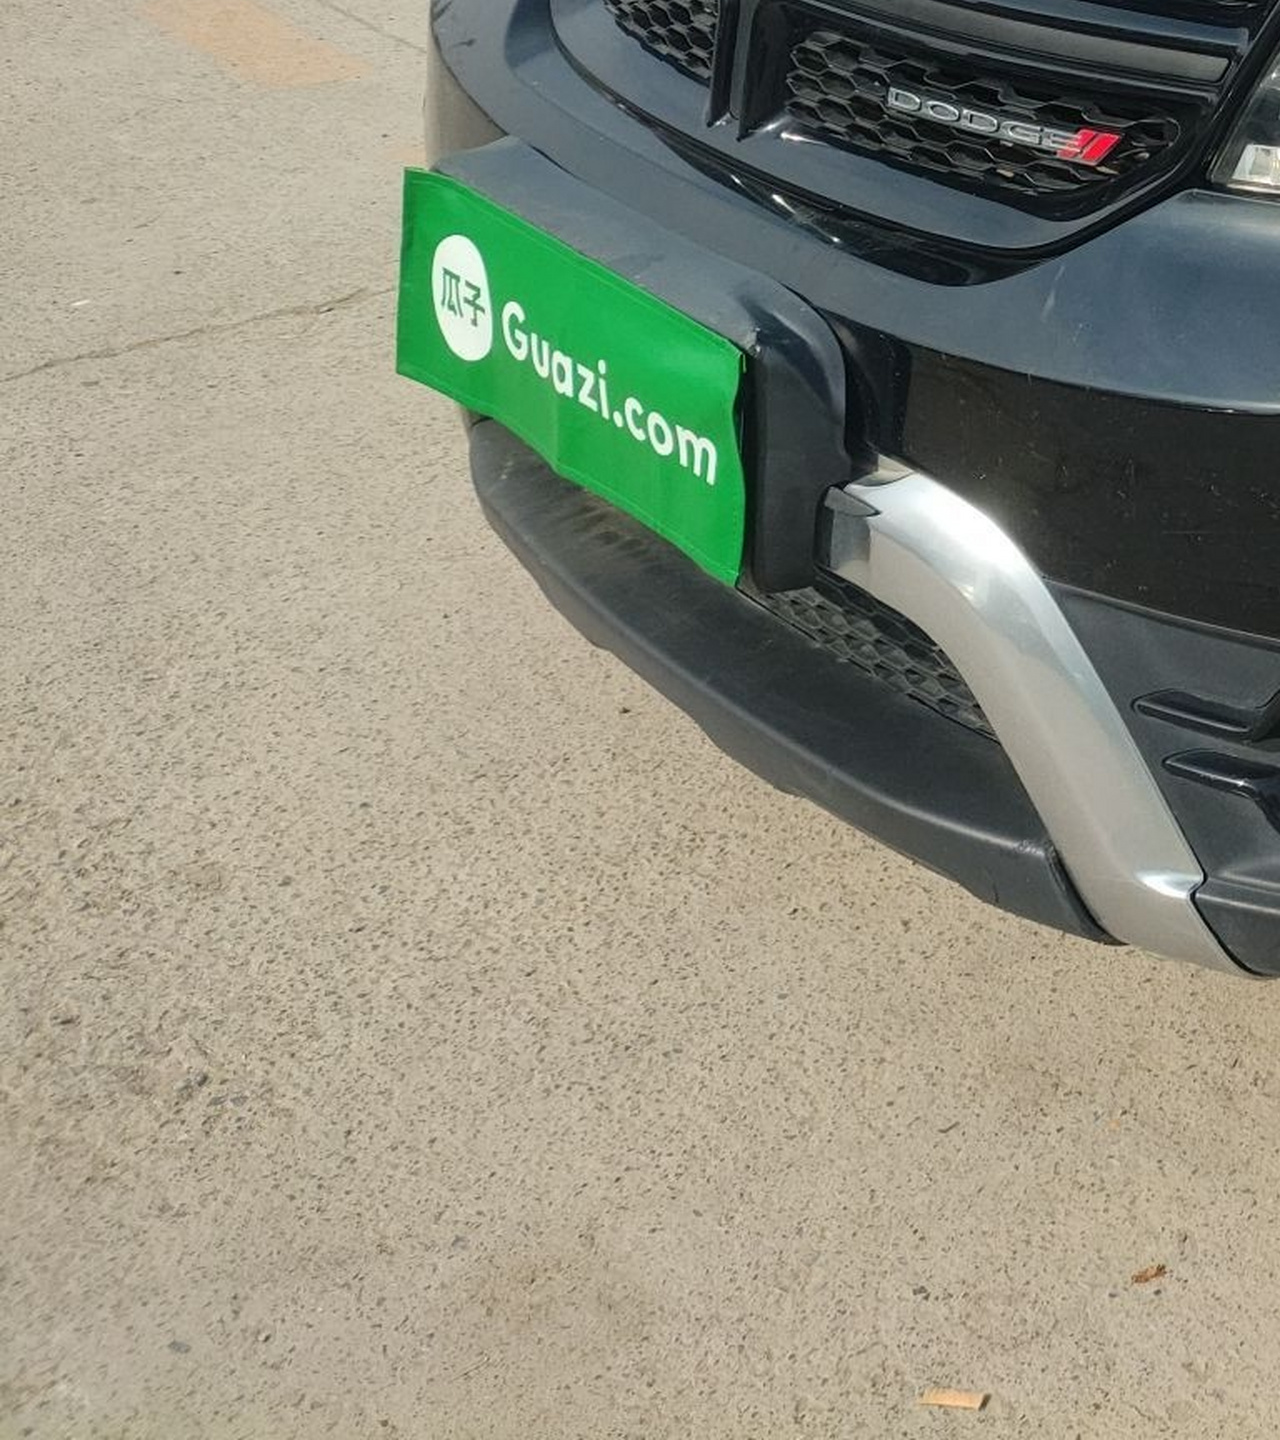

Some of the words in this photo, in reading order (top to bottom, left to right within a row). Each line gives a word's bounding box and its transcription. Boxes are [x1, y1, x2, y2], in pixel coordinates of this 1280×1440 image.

[887, 86, 1081, 152] DODGE
[440, 266, 486, 328] 瓜子
[501, 300, 718, 487] Guazi.com
